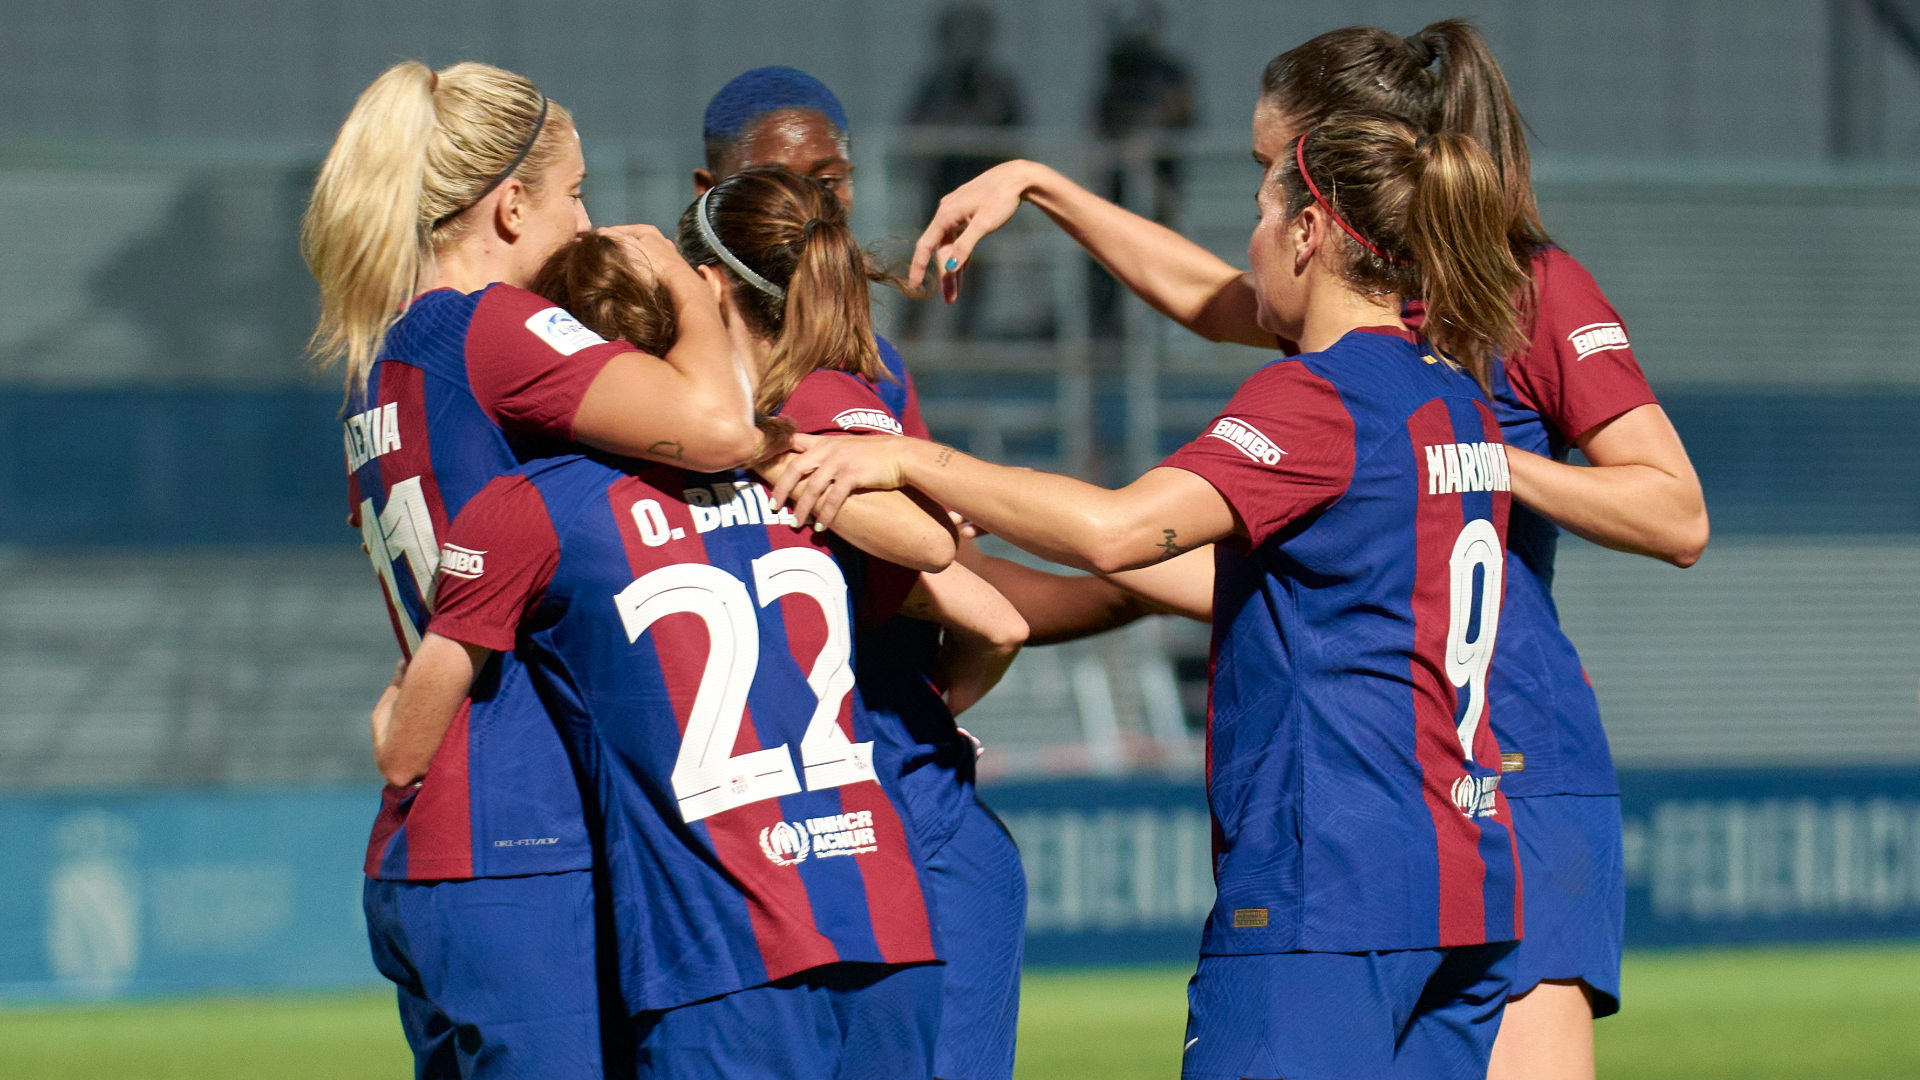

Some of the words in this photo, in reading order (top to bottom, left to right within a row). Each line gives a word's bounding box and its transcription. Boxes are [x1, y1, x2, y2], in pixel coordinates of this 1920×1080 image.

[1572, 326, 1629, 355] BIMBO
[836, 411, 903, 434] BIMBO
[1211, 419, 1281, 466] BIMBO
[1424, 441, 1511, 495] MARIONA
[631, 498, 687, 547] O.
[361, 475, 441, 659] 11
[1445, 518, 1504, 761] 9
[613, 546, 881, 824] 22
[805, 810, 874, 836] UNHCR
[813, 827, 877, 852] ACNUR
